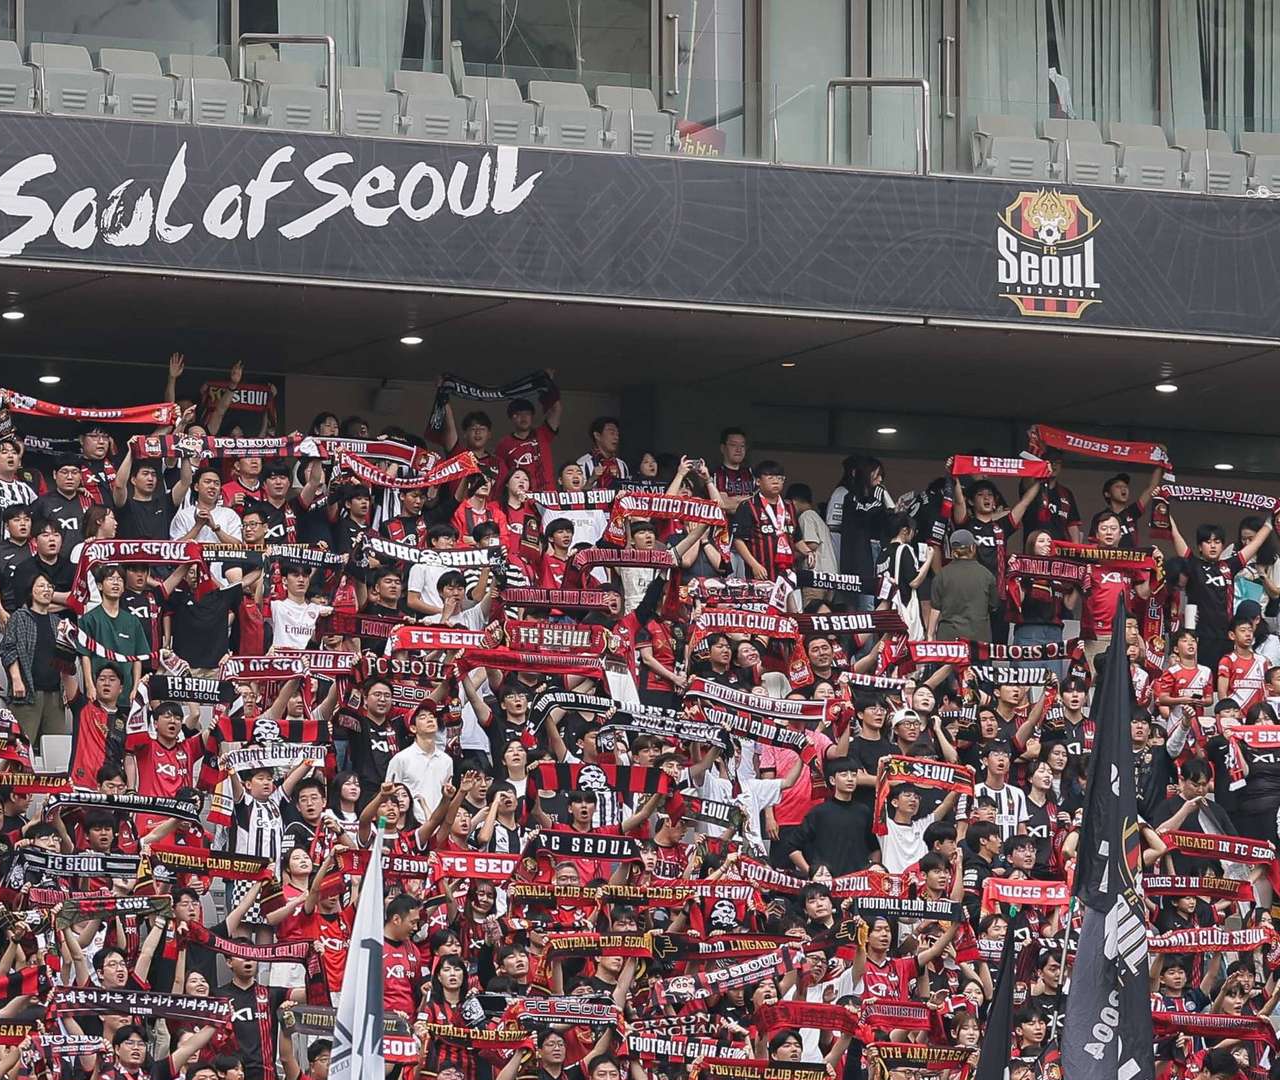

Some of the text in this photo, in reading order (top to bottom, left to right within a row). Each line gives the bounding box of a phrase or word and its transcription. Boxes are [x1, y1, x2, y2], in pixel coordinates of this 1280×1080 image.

[203, 145, 296, 241] of
[997, 226, 1101, 288] Seoul
[371, 538, 489, 567] SUHO SHIN
[1081, 547, 1147, 563] ANNIVERSARY
[812, 613, 875, 630] FC SEOUL
[409, 631, 431, 645] FC
[520, 627, 591, 648] FC SEOUL
[368, 657, 446, 680] FC SEOUL
[168, 676, 221, 694] FC SEOUL
[912, 763, 953, 785] SEOUL
[540, 834, 632, 855] FC SEOUL
[47, 854, 104, 872] FC SEOUL
[206, 856, 230, 872] CLUB
[443, 857, 467, 872] FC
[858, 897, 952, 914] FOOTBALL CLUB SEOUL
[730, 938, 777, 952] LINGARD
[177, 998, 229, 1016] 지켜주리라
[709, 1063, 762, 1078] FOOTBALL
[765, 1066, 791, 1080] CLUB
